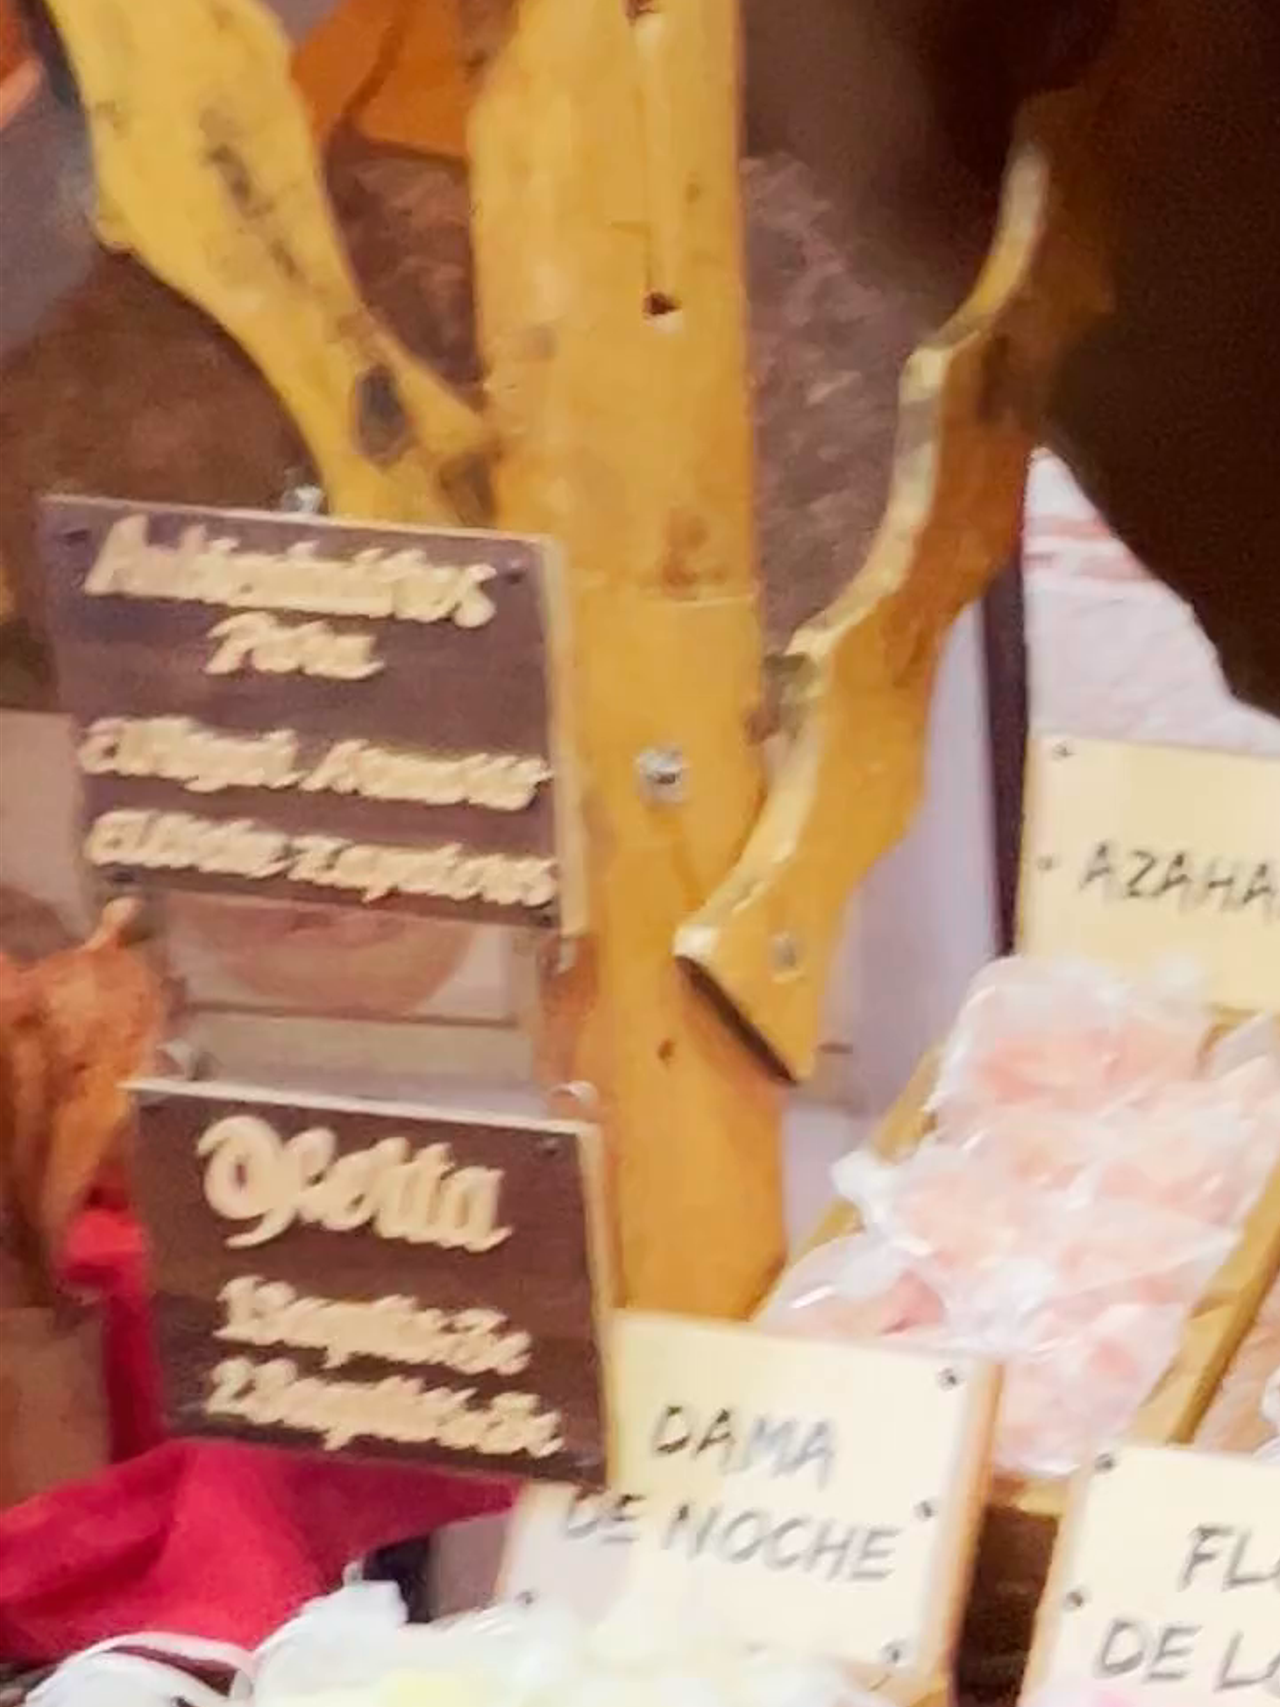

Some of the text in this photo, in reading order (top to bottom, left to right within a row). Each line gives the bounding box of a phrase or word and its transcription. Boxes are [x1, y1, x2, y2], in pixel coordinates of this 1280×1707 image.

[650, 1403, 839, 1491] DAMA
[563, 1492, 903, 1584] DE NOCHE
[1094, 1617, 1204, 1683] DE
